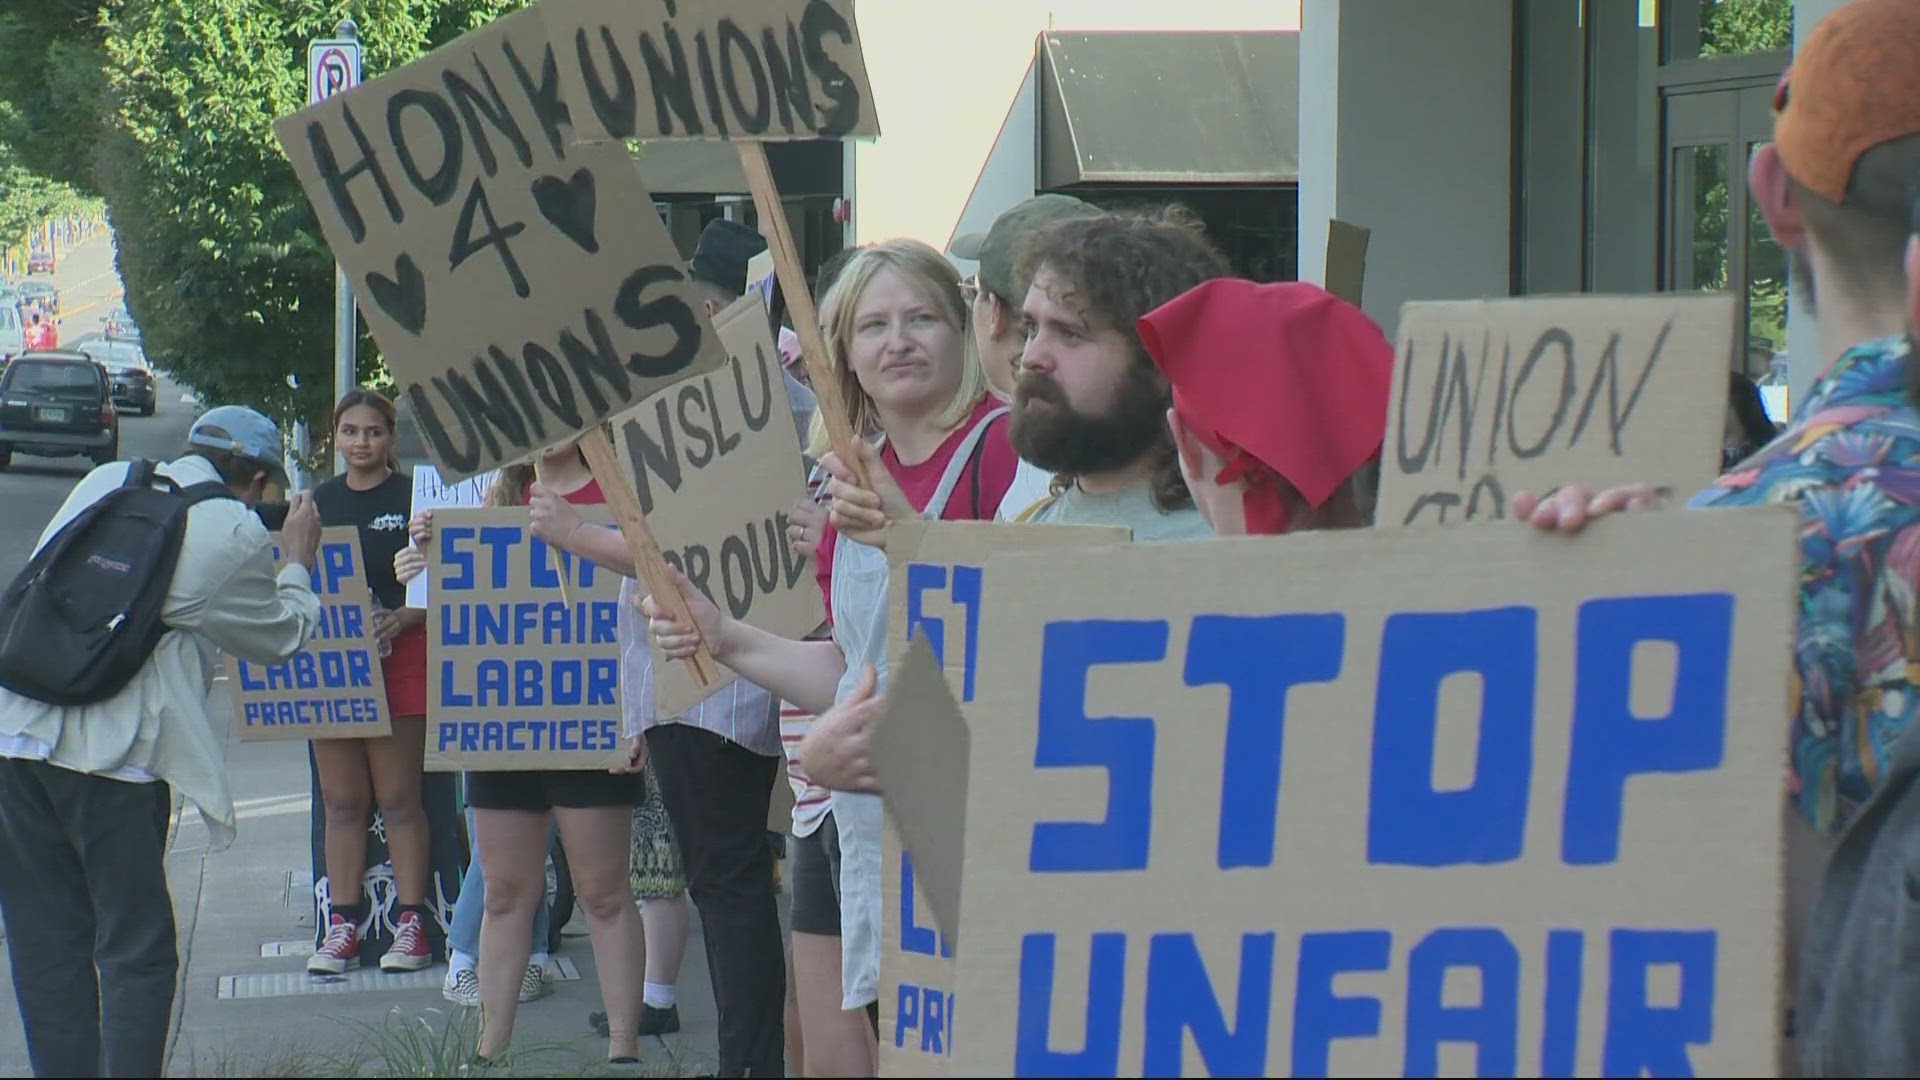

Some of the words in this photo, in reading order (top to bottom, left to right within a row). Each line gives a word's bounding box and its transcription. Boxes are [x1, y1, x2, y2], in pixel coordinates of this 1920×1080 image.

[575, 0, 860, 140] UNIONS
[306, 40, 574, 244] HONK
[449, 176, 531, 299] 4
[408, 264, 702, 474] UNIONS
[622, 343, 772, 517] NSLU
[1398, 312, 1674, 482] UNION
[239, 649, 372, 692] LABOR
[440, 602, 618, 646] UNFAIR
[440, 659, 618, 707] LABOR
[244, 698, 379, 726] PRACTICES
[438, 720, 618, 752] PRACTICES
[1029, 592, 1736, 873] STOP
[1014, 927, 1717, 1078] UNFAIR
